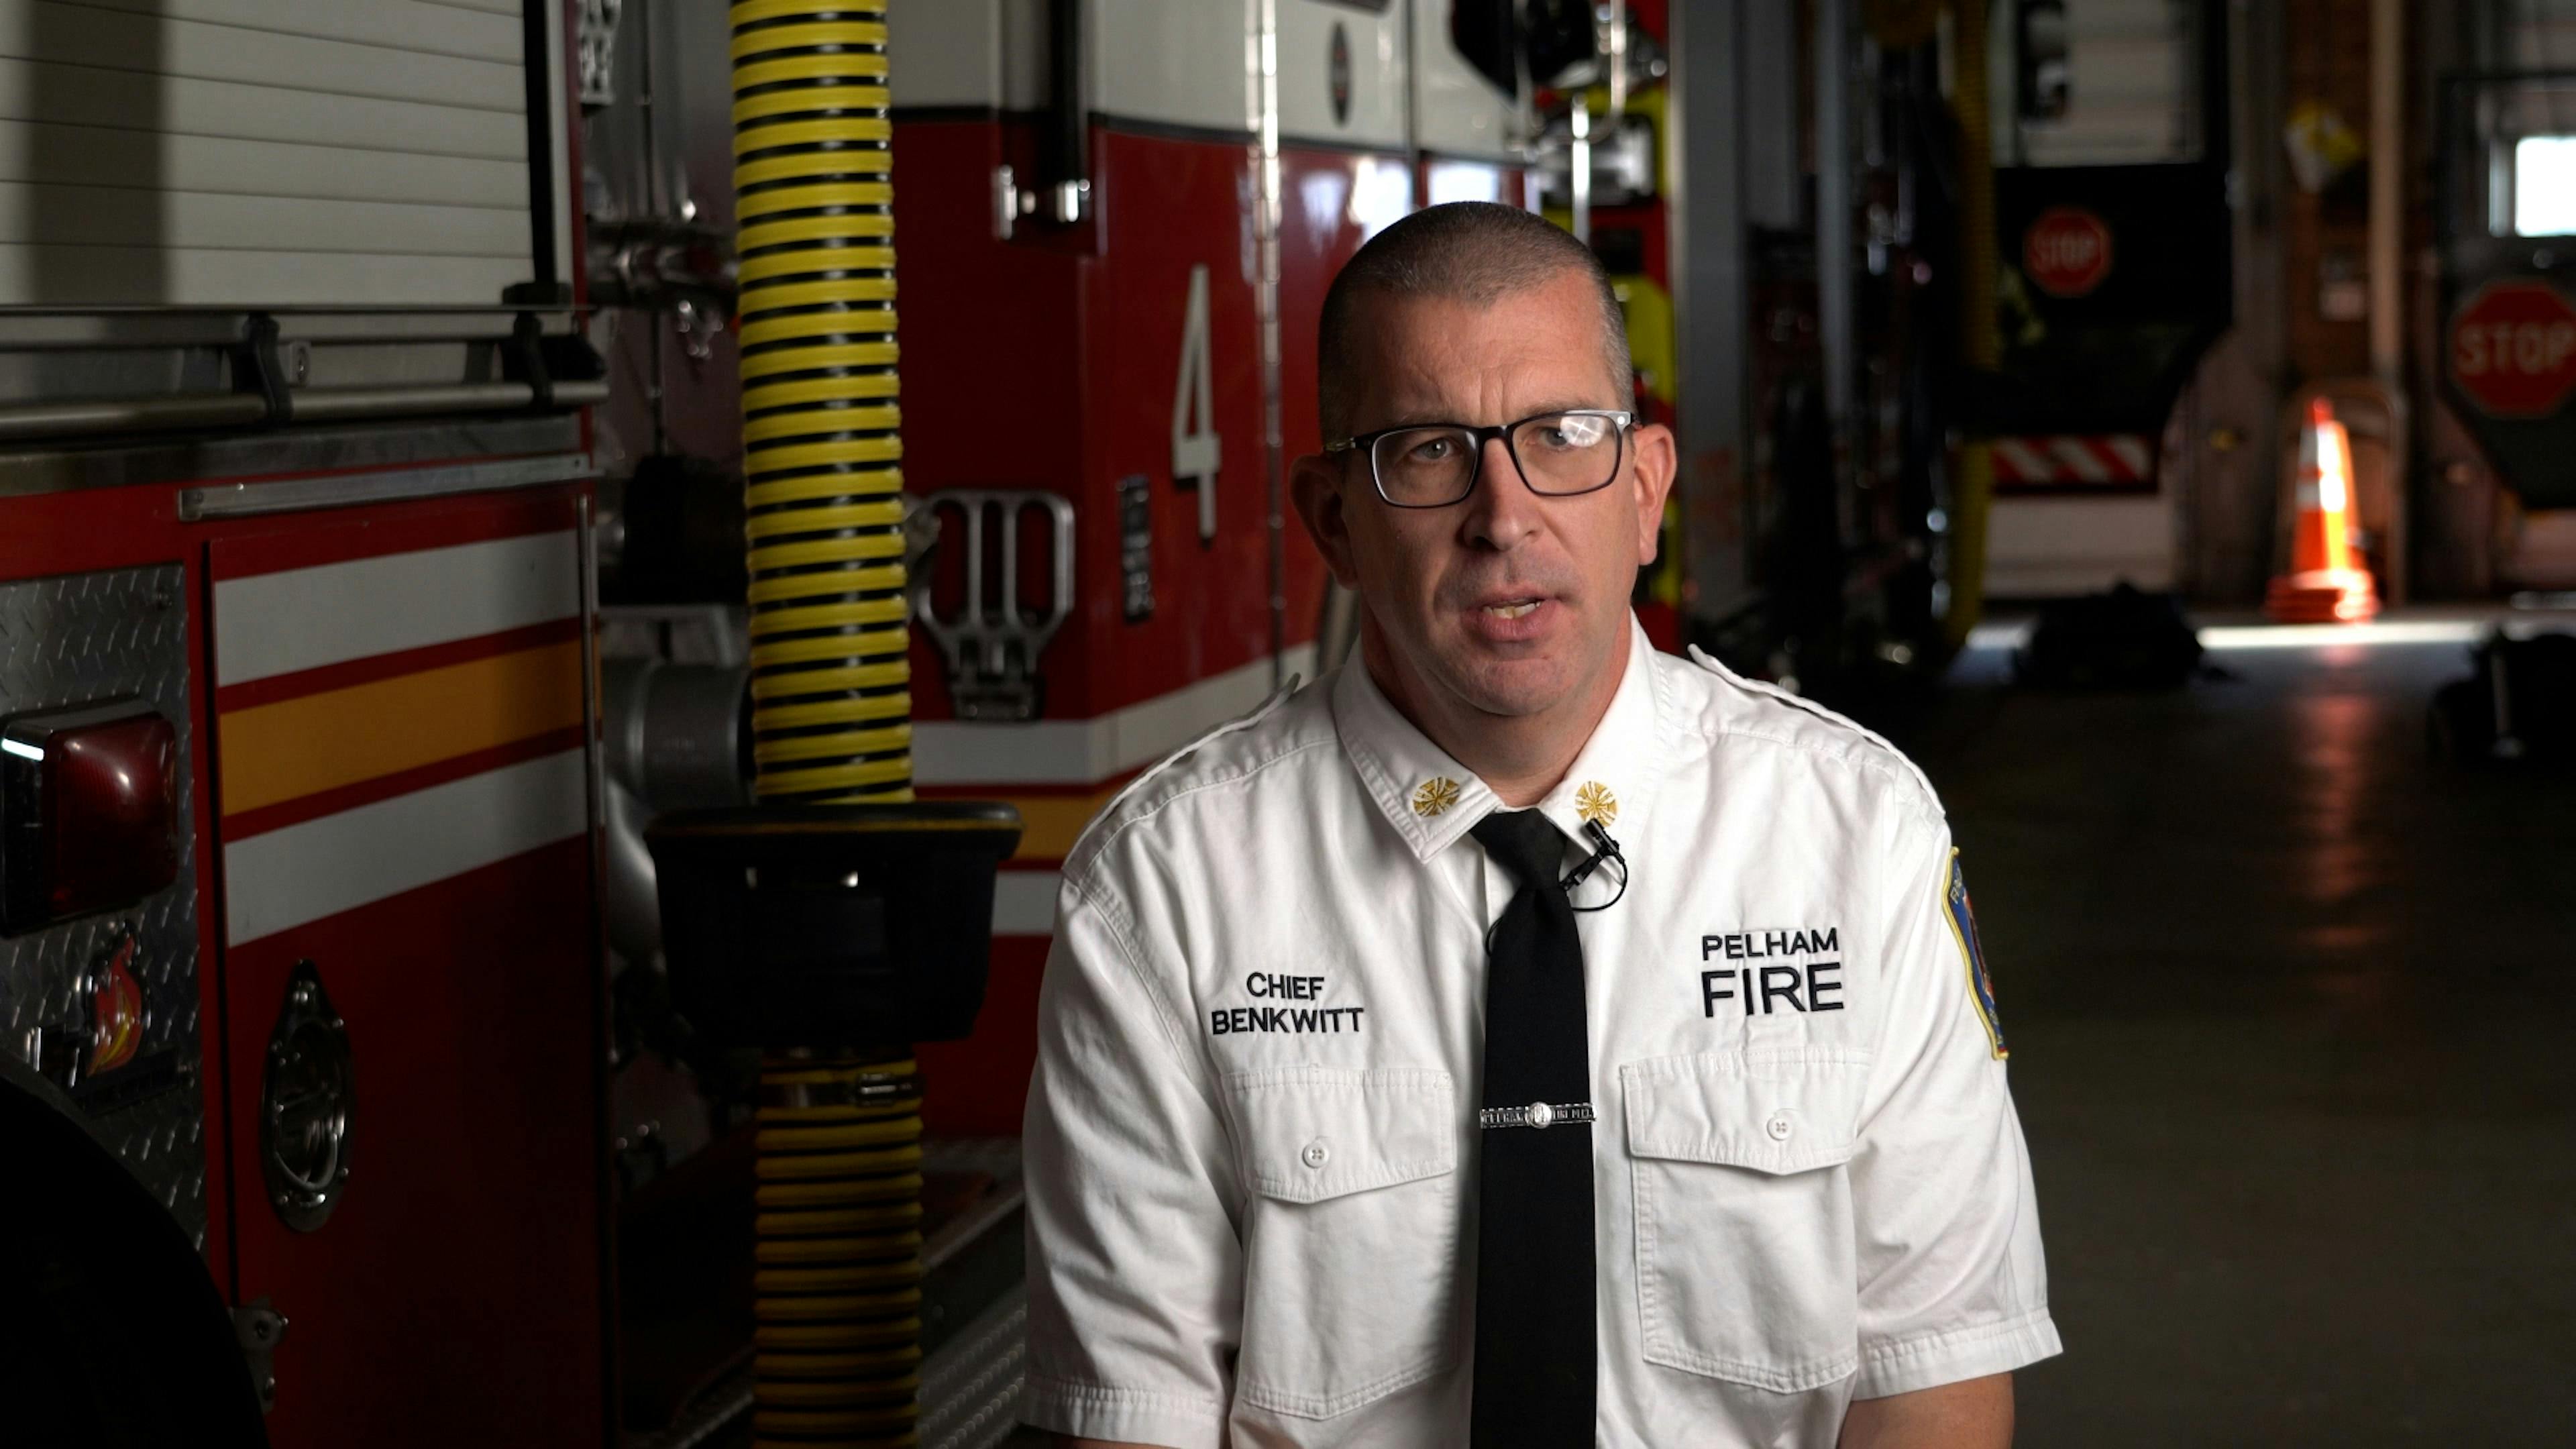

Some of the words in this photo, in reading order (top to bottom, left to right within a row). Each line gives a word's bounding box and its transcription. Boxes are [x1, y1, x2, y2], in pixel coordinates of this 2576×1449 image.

[2033, 232, 2097, 272] STOP
[2455, 321, 2575, 375] STOP
[1171, 263, 1222, 537] 4
[1702, 927, 1839, 961] PELHAM
[1246, 971, 1325, 1001] CHIEF
[1701, 962, 1844, 1018] FIRE
[1212, 1008, 1364, 1035] BENKWITT
